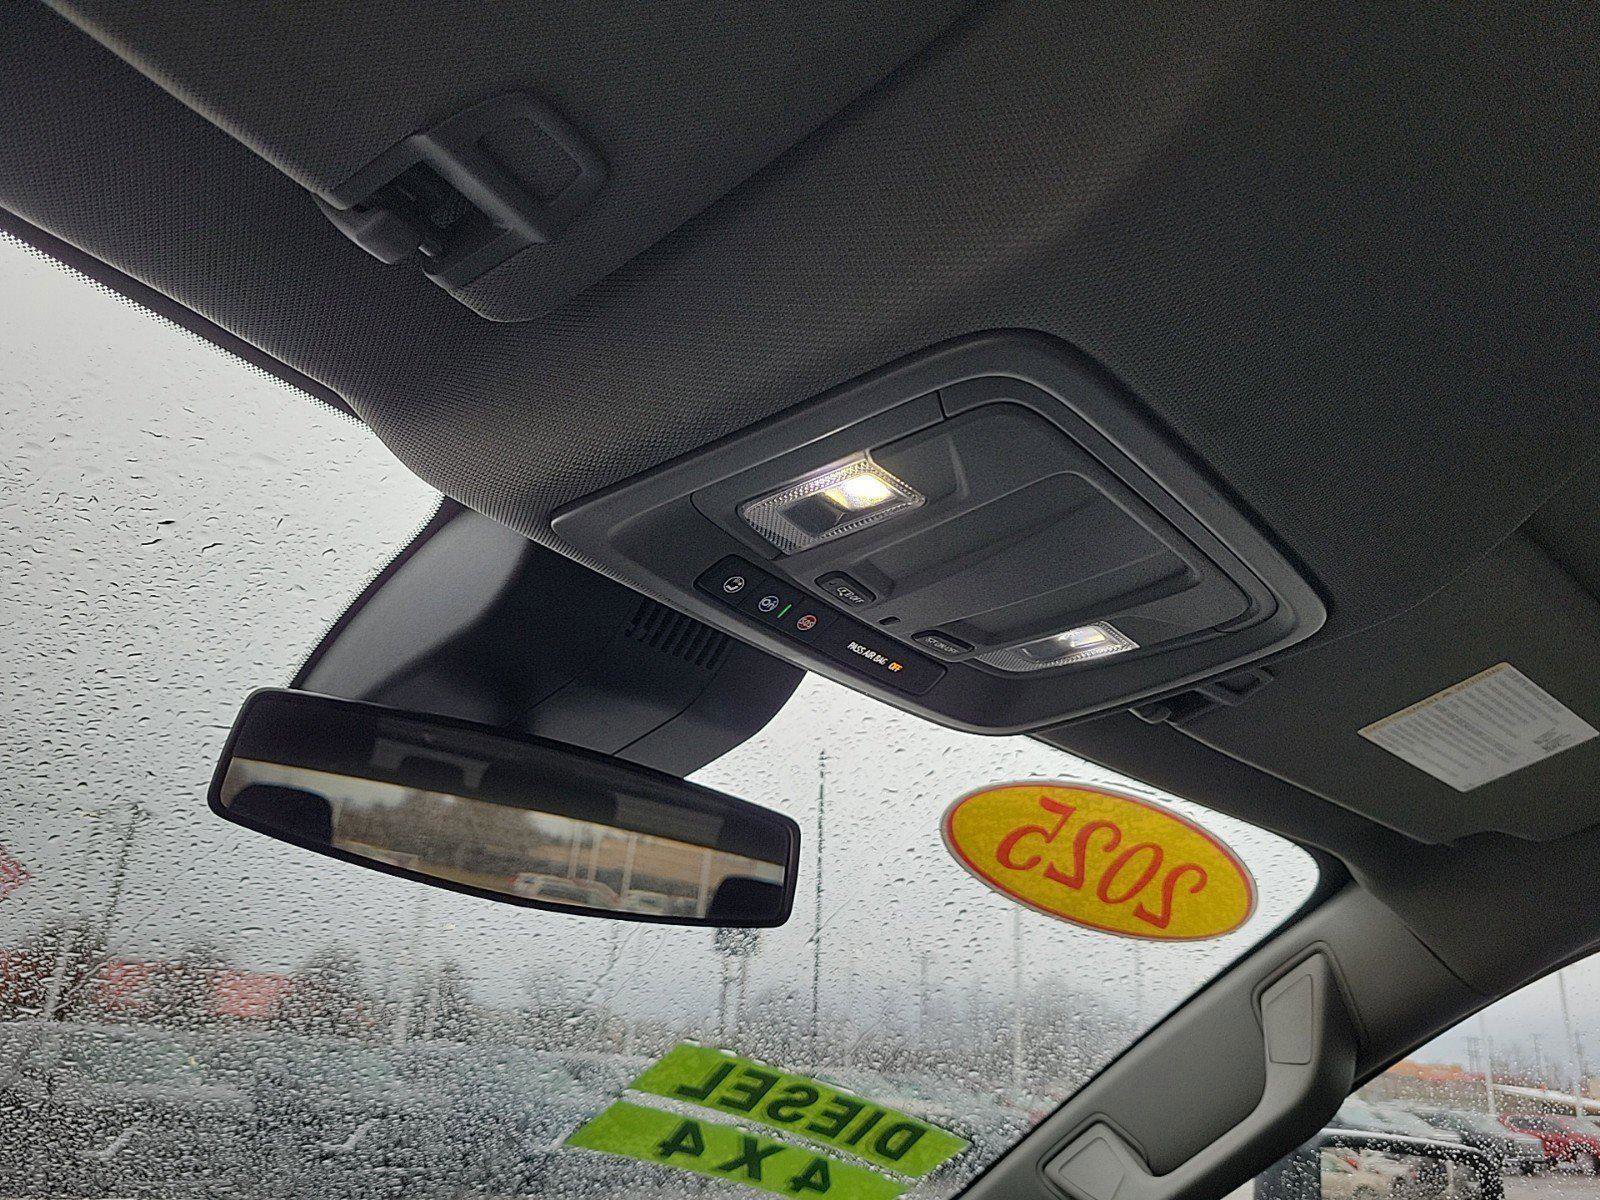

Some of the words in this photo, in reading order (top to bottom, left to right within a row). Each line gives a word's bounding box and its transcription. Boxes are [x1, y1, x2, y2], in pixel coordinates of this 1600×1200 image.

[847, 641, 866, 656] PASS
[864, 649, 877, 660] AIR
[873, 654, 889, 666] BAG
[888, 661, 903, 673] OFF
